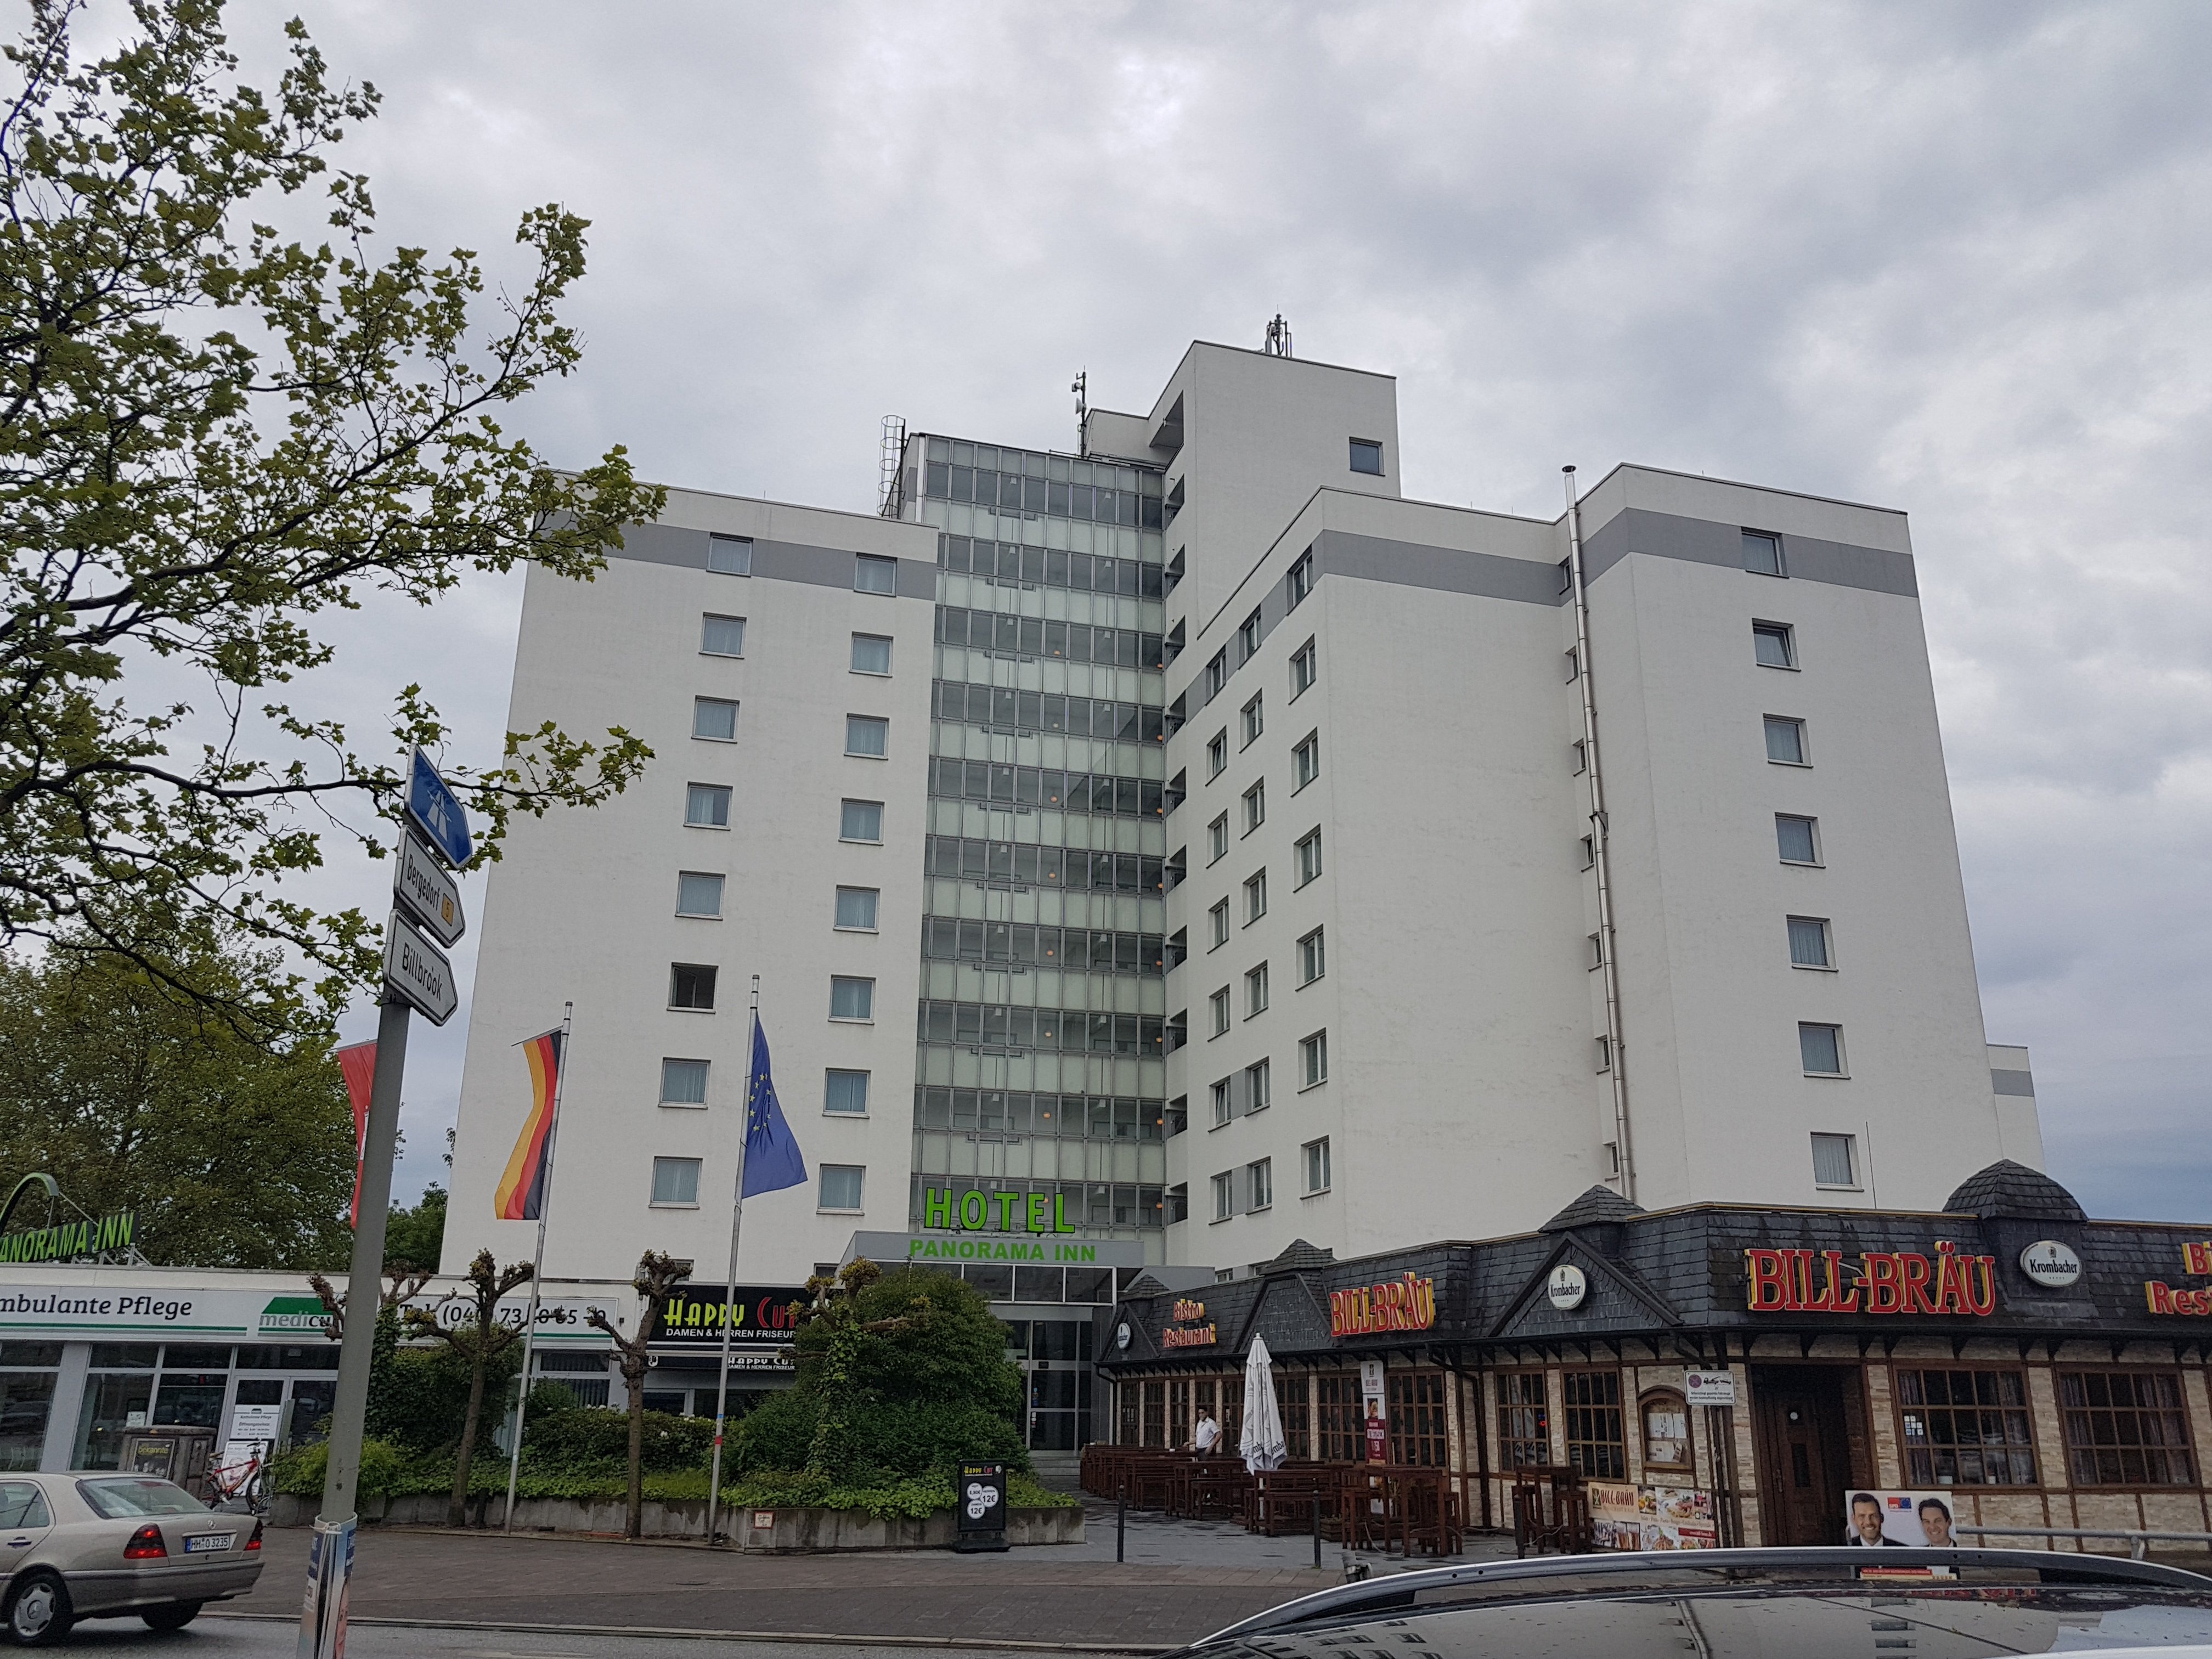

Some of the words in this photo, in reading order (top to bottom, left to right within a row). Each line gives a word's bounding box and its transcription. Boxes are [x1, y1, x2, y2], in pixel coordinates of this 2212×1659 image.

[407, 854, 440, 911] Bergedorf
[445, 901, 450, 918] 5
[402, 942, 442, 1002] Billbrook
[924, 1187, 1075, 1234] HOTEL
[0, 1221, 88, 1263] ANORAMA
[94, 1212, 134, 1250] INN
[910, 1238, 1045, 1261] PANORAMA
[1054, 1244, 1096, 1262] INN
[1745, 1240, 1996, 1316] BILL-BRÄU
[2029, 1259, 2077, 1273] Krombacher
[1550, 1282, 1581, 1297] Krombacher
[0, 1294, 111, 1314] mbulante
[117, 1296, 192, 1320] Pflege
[1173, 1299, 1205, 1322] Bistro
[1330, 1271, 1434, 1337] BILL-BRÄU
[259, 1310, 331, 1327] medicu
[666, 1328, 704, 1337] DAMEN
[706, 1328, 713, 1337] &
[1163, 1323, 1216, 1348] Restaurant
